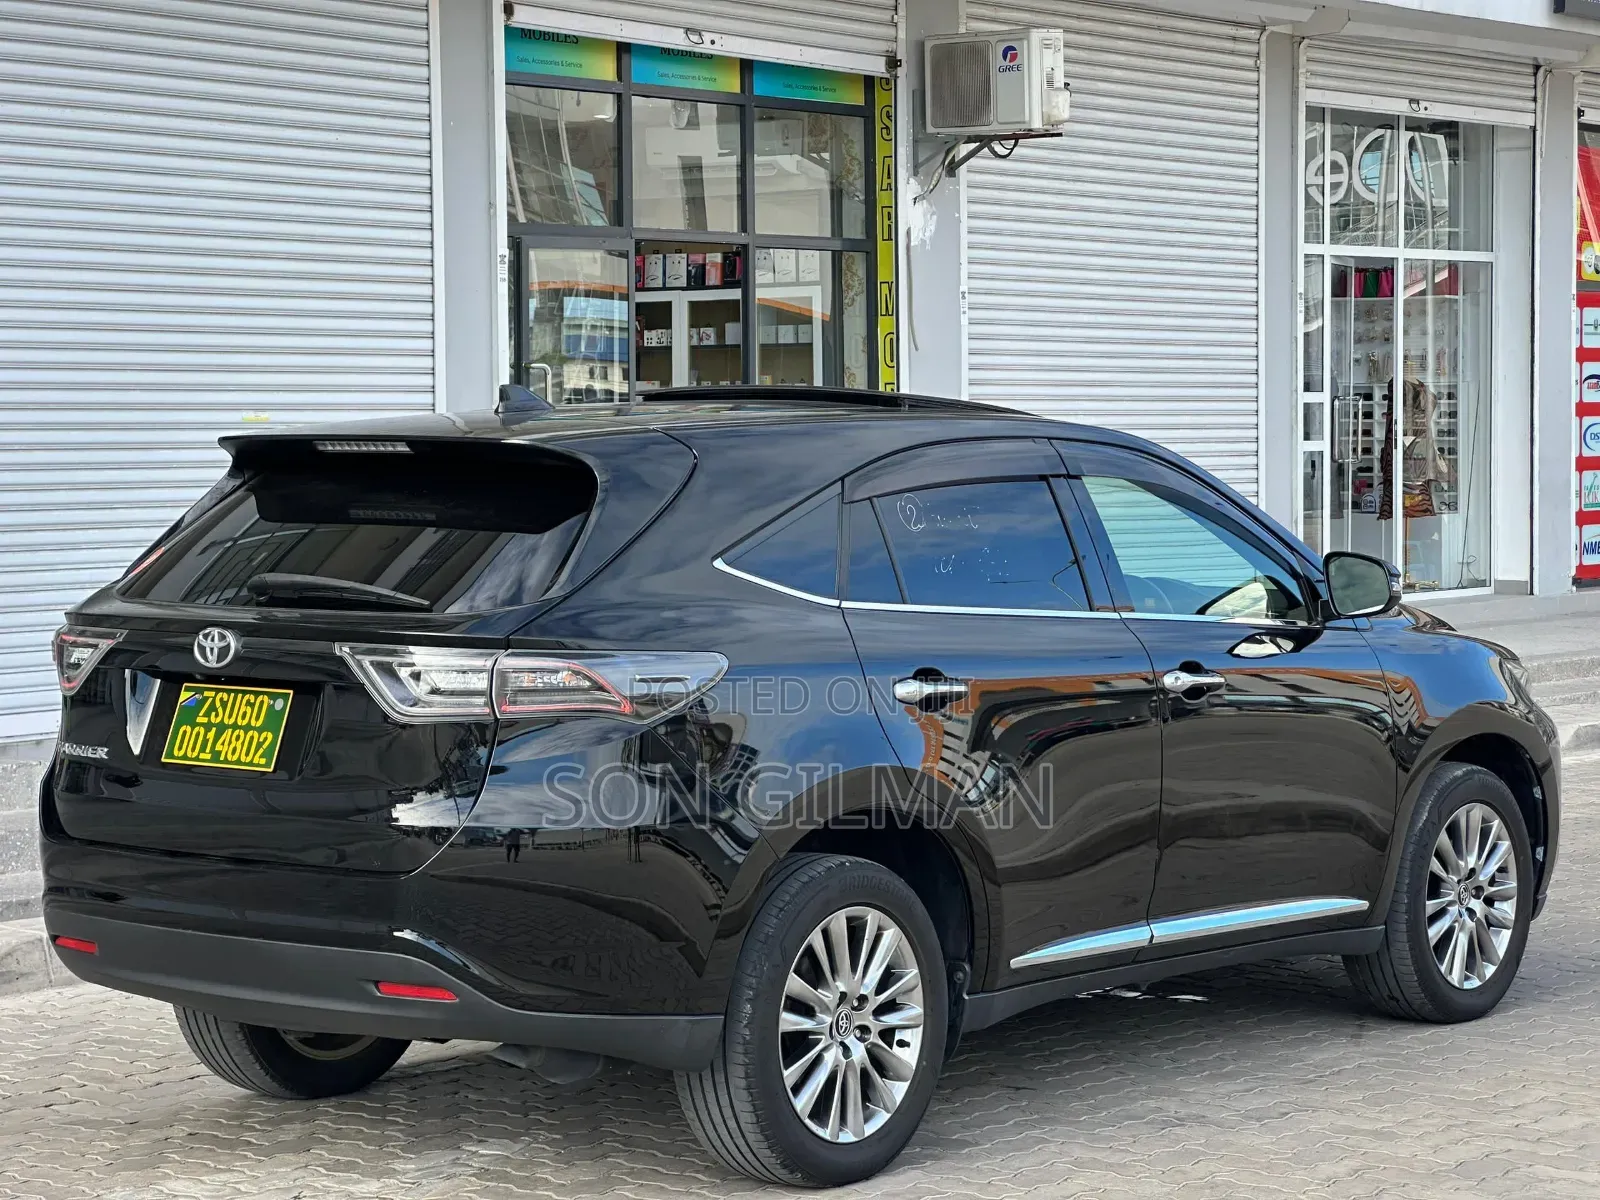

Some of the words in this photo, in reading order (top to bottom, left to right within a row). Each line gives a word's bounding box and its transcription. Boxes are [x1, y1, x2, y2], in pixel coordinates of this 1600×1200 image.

[531, 58, 560, 67] Accessories
[565, 60, 583, 68] Service
[998, 63, 1023, 73] GREE
[701, 74, 717, 83] Service
[196, 691, 269, 727] ZSU60
[174, 725, 273, 764] 0014802
